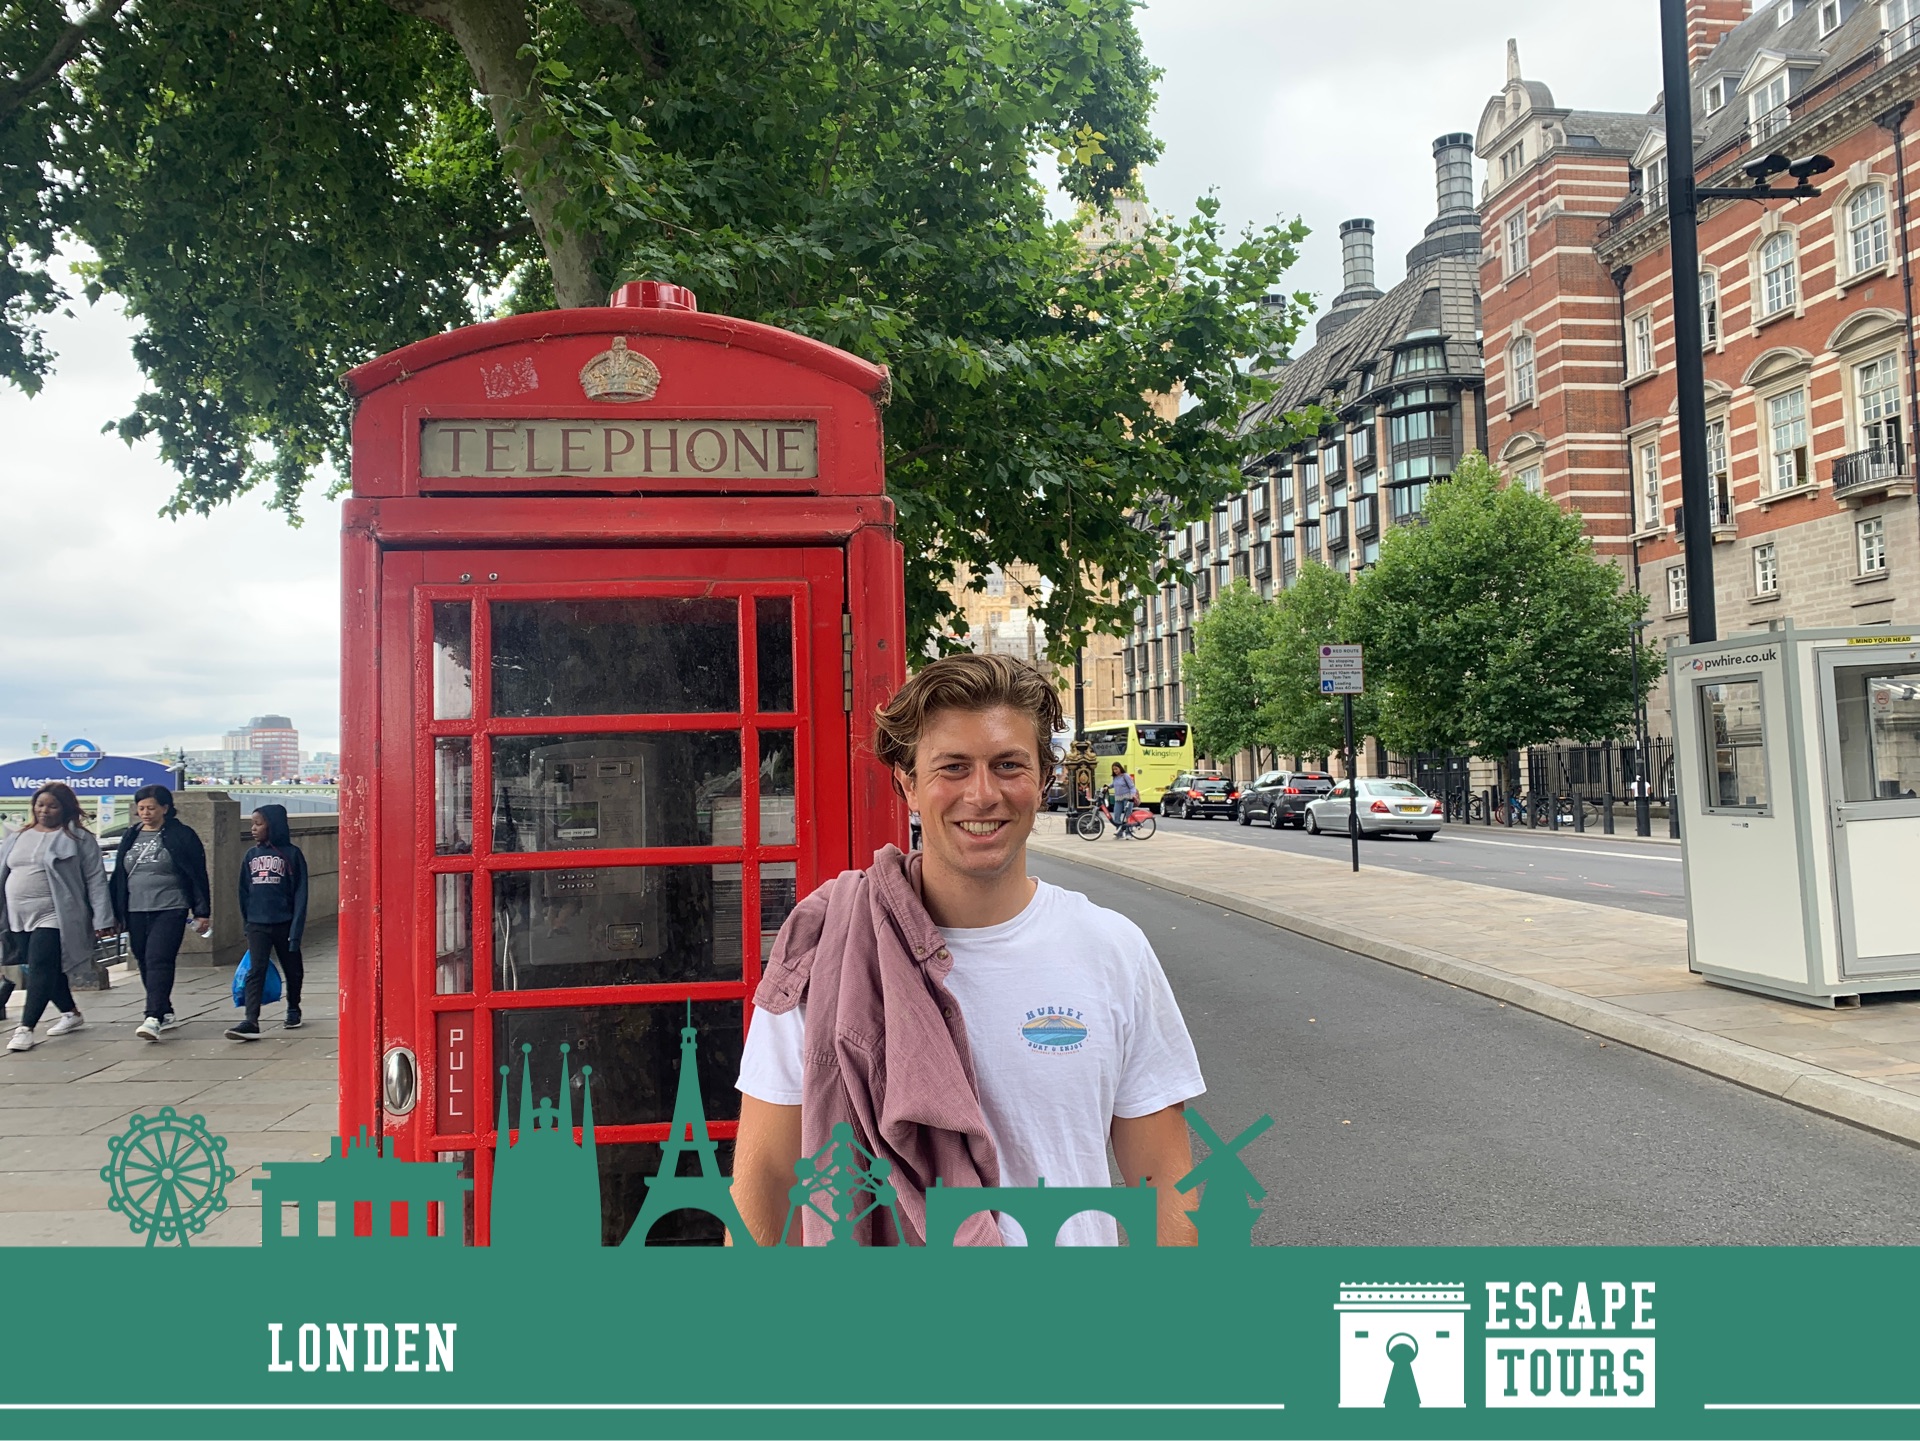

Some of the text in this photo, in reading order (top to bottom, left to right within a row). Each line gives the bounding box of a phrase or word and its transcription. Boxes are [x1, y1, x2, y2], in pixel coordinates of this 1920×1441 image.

[438, 427, 805, 474] TELEPHONE
[1704, 649, 1777, 671] pwhire.co.uk
[114, 774, 143, 787] Pier
[1025, 1006, 1083, 1020] HURLEY
[1027, 1041, 1048, 1051] SURF
[1060, 1042, 1083, 1052] ENJOY
[449, 1028, 464, 1116] PULL
